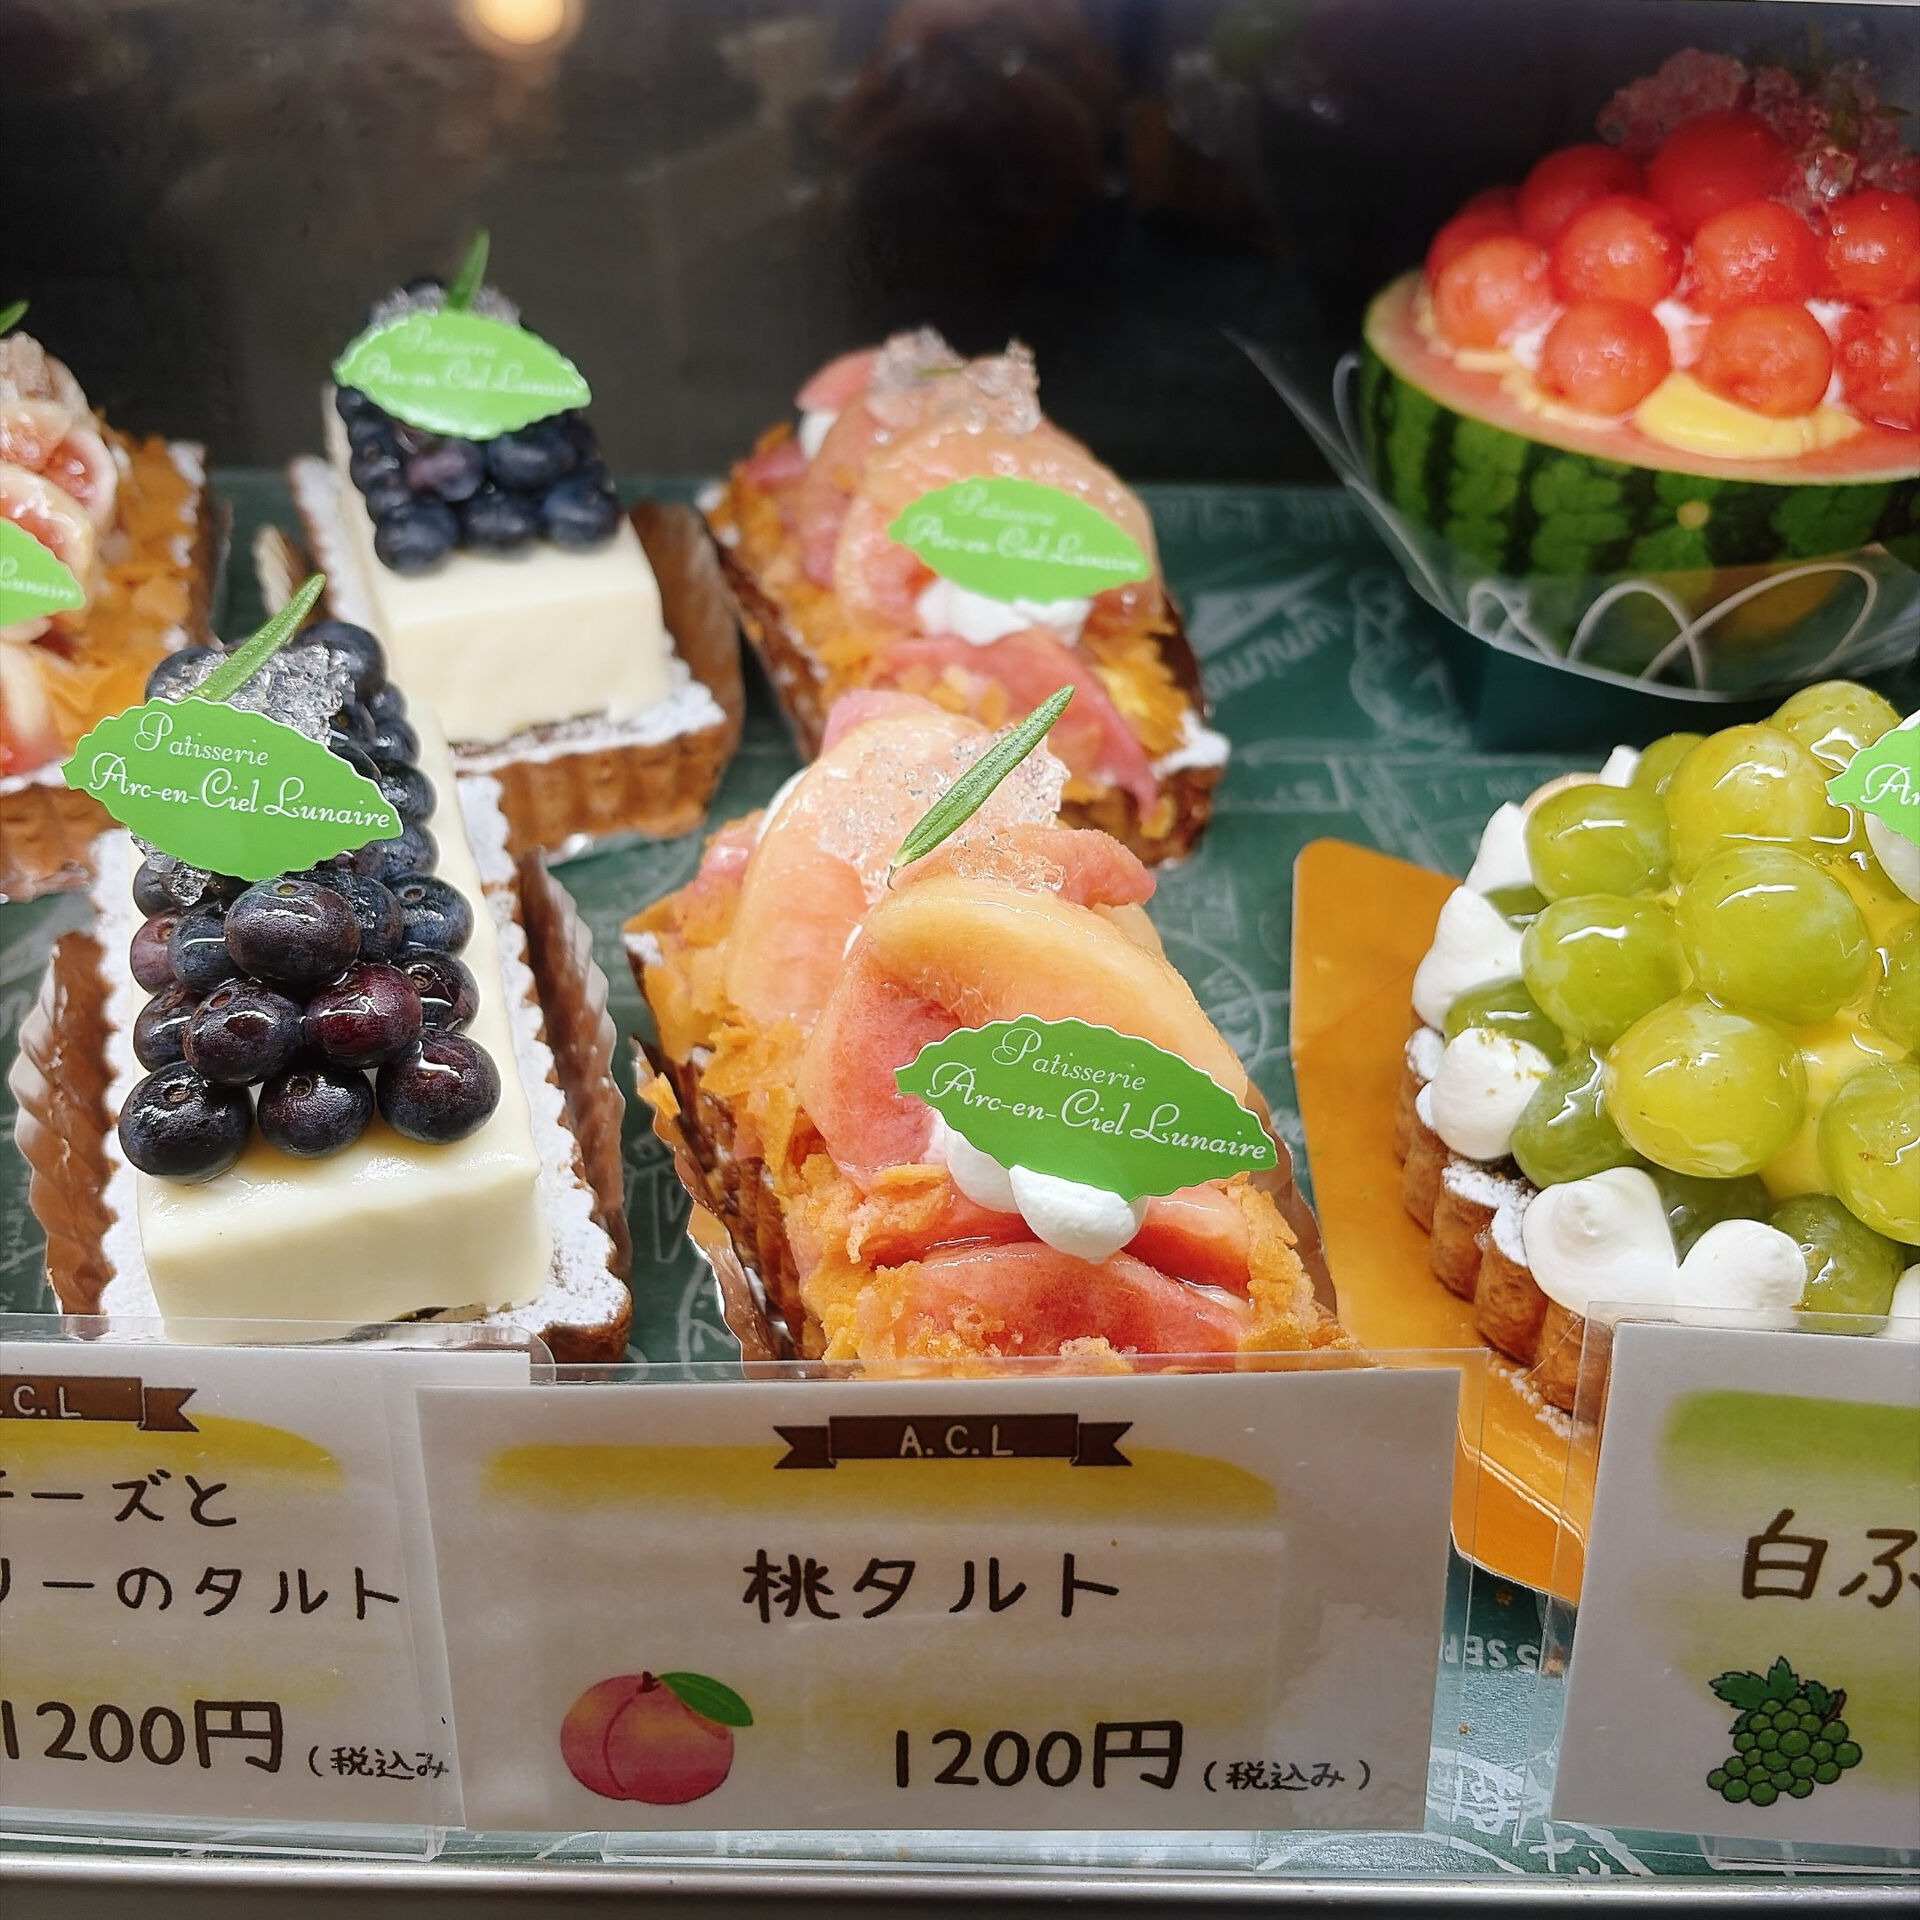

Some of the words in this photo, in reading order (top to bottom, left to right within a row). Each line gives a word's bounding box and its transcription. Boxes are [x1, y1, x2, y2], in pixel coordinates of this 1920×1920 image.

[134, 711, 269, 768] Patisserie
[89, 752, 259, 815] Arc-en-Ciel
[262, 777, 391, 830] Lunaire
[991, 1027, 1147, 1091] Patisserie
[925, 1061, 1131, 1136] Arc-en-Ciel
[1129, 1102, 1268, 1160] Lunaire
[900, 1424, 1014, 1459] A.C.L
[742, 1549, 1120, 1623] 桃タルト
[1, 1699, 284, 1773] 1200円
[895, 1719, 1184, 1790] 1200円
